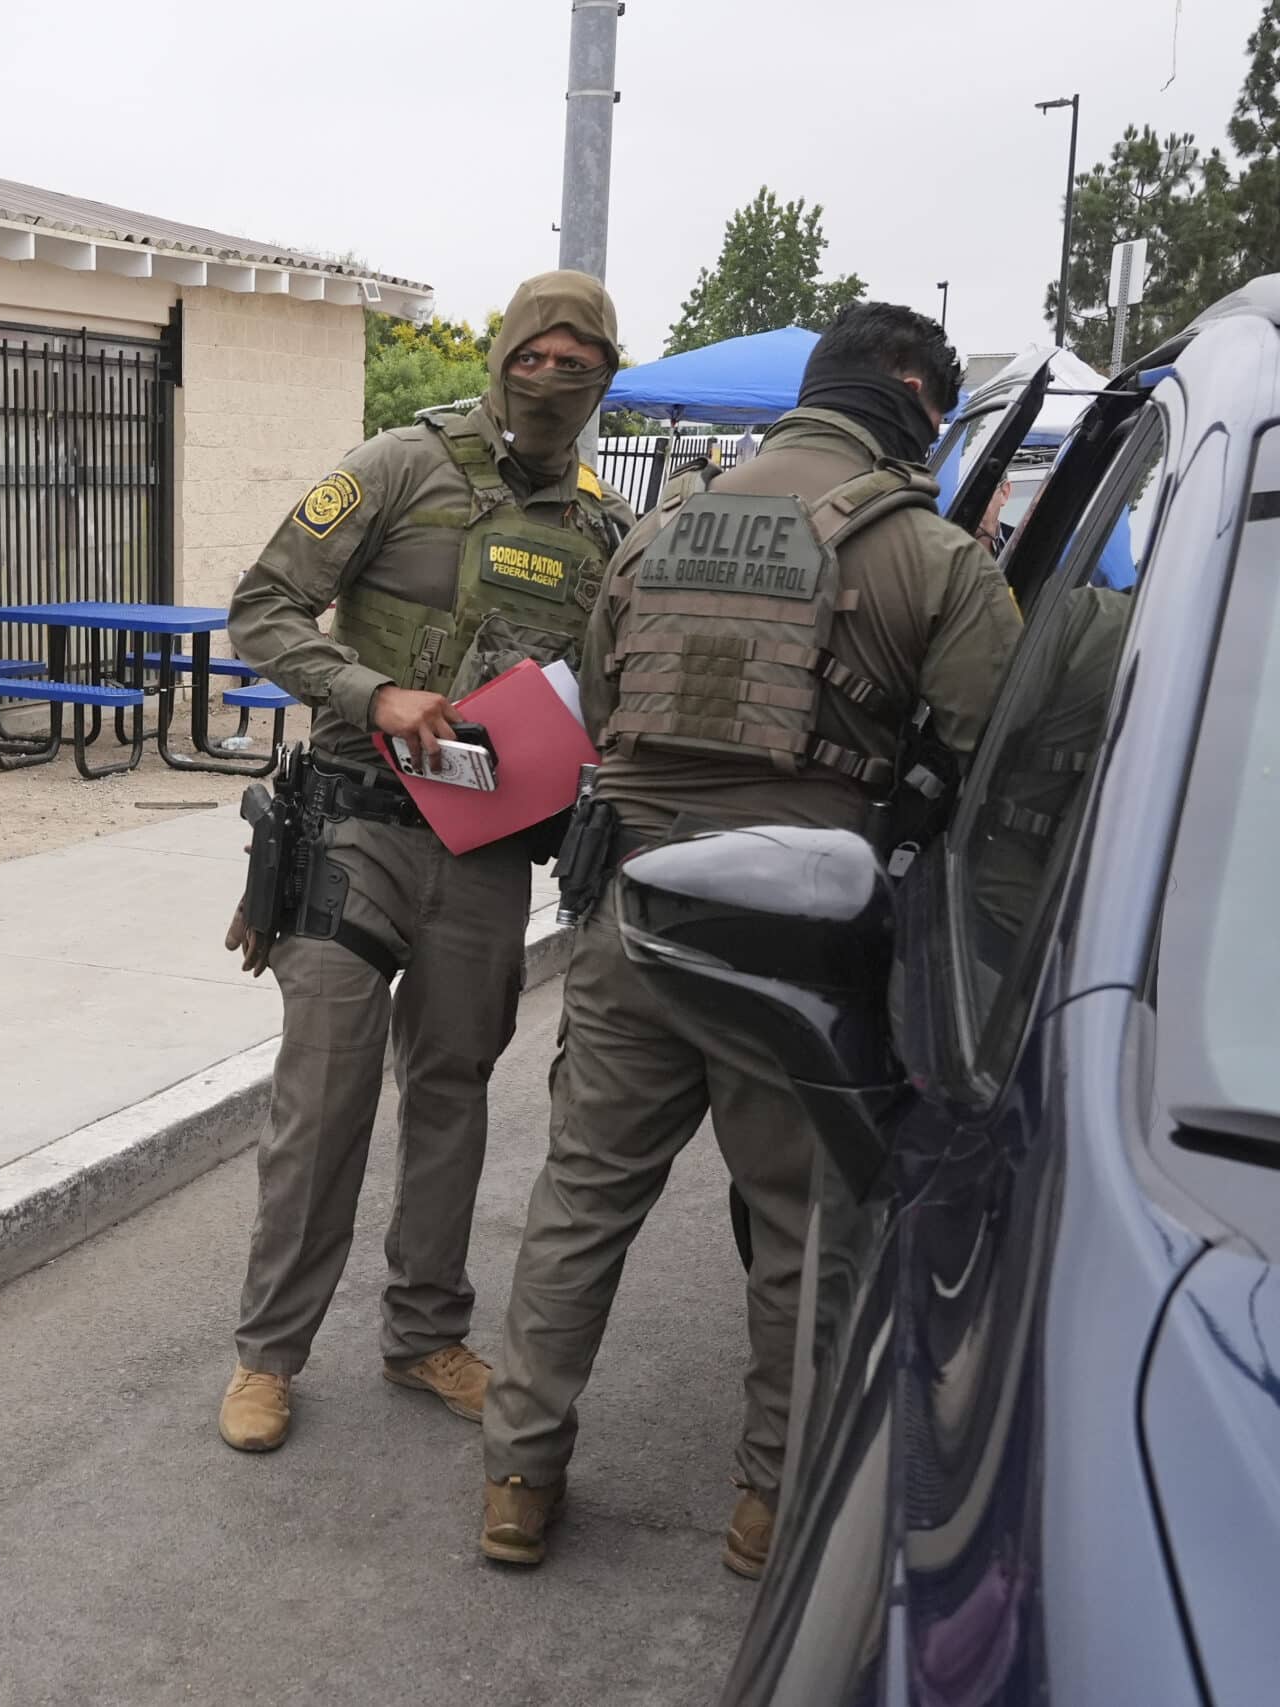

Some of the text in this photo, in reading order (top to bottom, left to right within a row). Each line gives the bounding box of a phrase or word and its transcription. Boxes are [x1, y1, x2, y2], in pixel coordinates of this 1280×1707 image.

[670, 511, 797, 561] POLICE
[489, 545, 564, 578] BORDER PATROL
[493, 562, 560, 588] FEDERAL AGENT
[641, 558, 808, 592] U.S. BORDER PATROL
